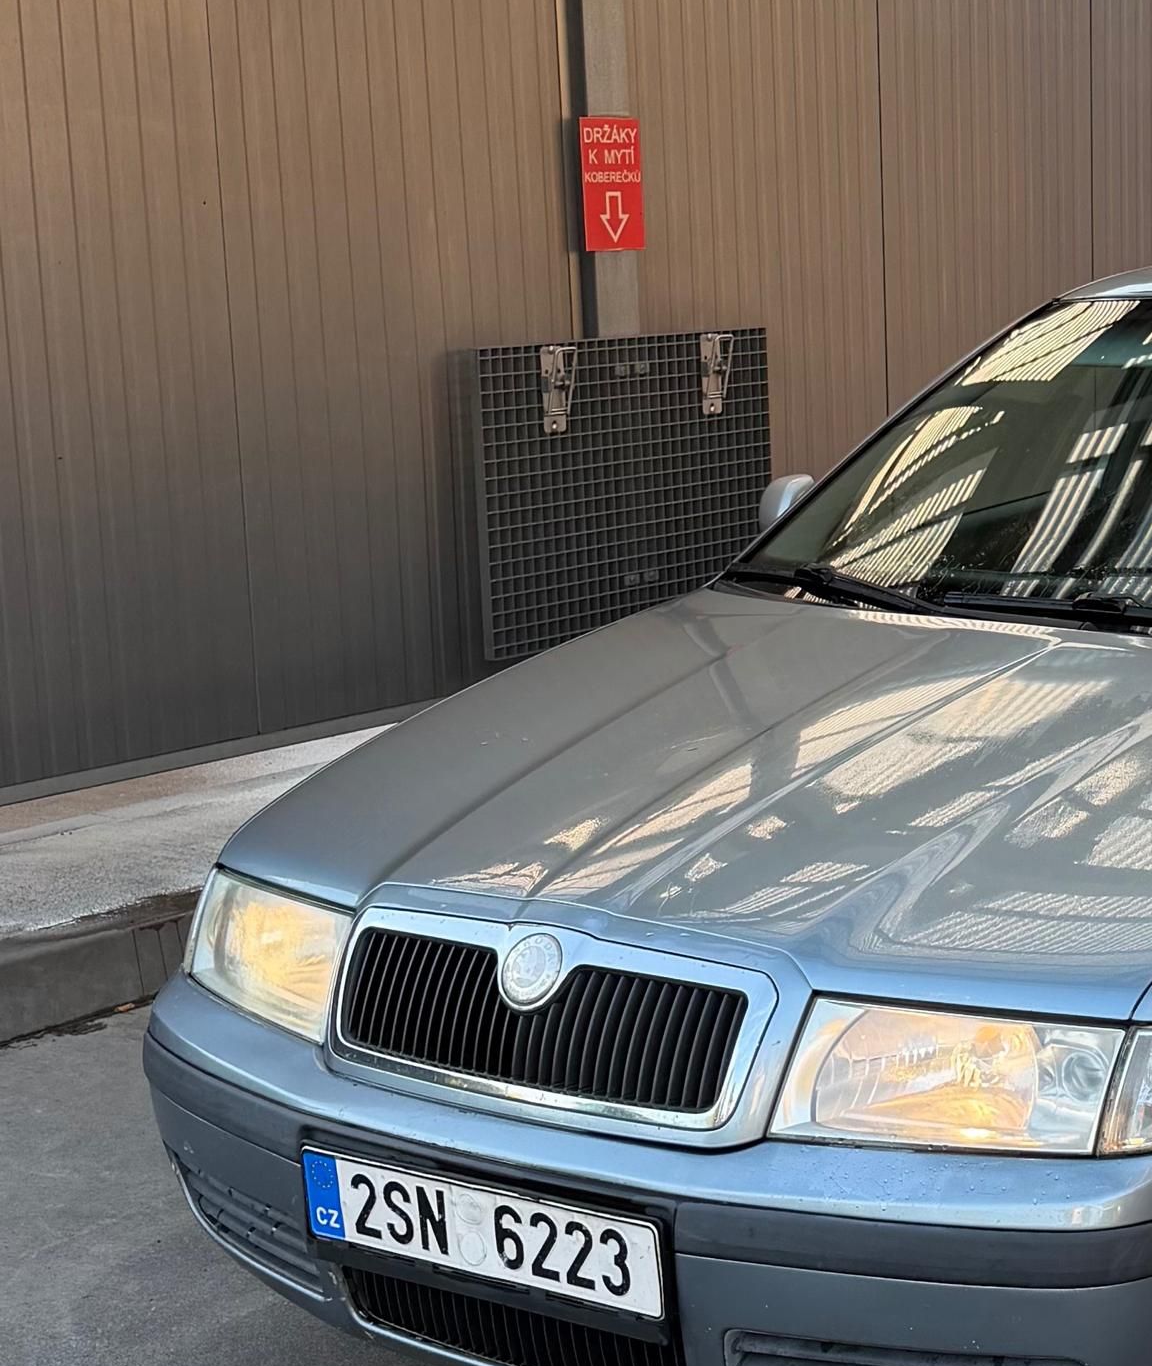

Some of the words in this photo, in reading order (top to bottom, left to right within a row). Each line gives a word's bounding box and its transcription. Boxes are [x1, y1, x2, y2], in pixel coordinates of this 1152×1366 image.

[583, 124, 637, 143] DRŽÁKY
[588, 149, 598, 164] K
[604, 146, 635, 164] MYTÍ
[584, 169, 641, 183] KOBEREČKŮ
[316, 1206, 340, 1229] CZ
[350, 1173, 449, 1256] 2SN
[494, 1204, 631, 1297] 6223
